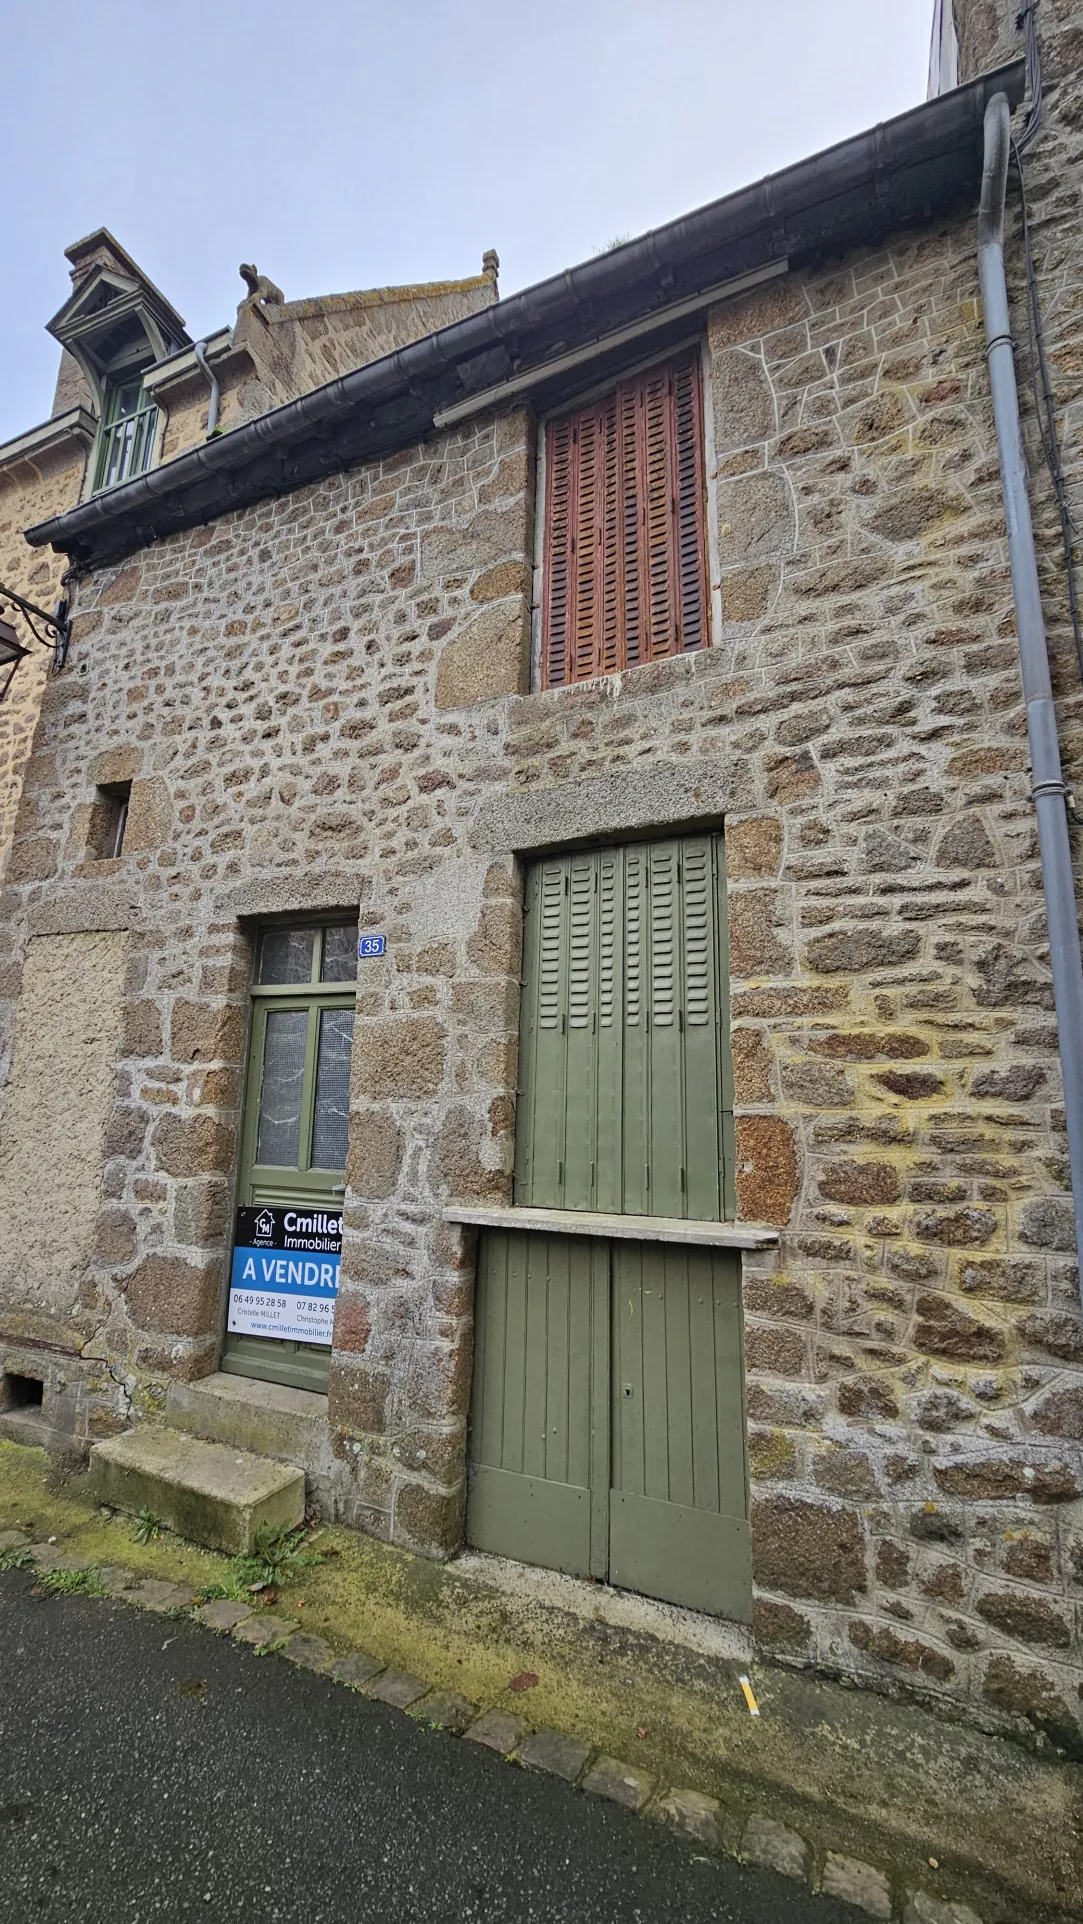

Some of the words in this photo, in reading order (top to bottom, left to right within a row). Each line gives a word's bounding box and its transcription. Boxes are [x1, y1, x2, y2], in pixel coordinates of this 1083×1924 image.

[364, 940, 379, 953] 35
[284, 1212, 343, 1234] Cmillet
[284, 1235, 341, 1251] Immobilier
[242, 1258, 256, 1280] A
[233, 1294, 242, 1304] 06
[244, 1296, 254, 1304] 49
[255, 1296, 264, 1306] 95
[266, 1298, 275, 1307] 28
[277, 1298, 286, 1308] 58
[296, 1301, 306, 1310] 07
[307, 1302, 317, 1312] 82
[319, 1304, 330, 1313] 96
[237, 1308, 259, 1317] Cristelle
[260, 1310, 280, 1319] MILLET
[296, 1314, 328, 1325] Christophe
[250, 1322, 332, 1338] www.cmilletimmobilier.fr
